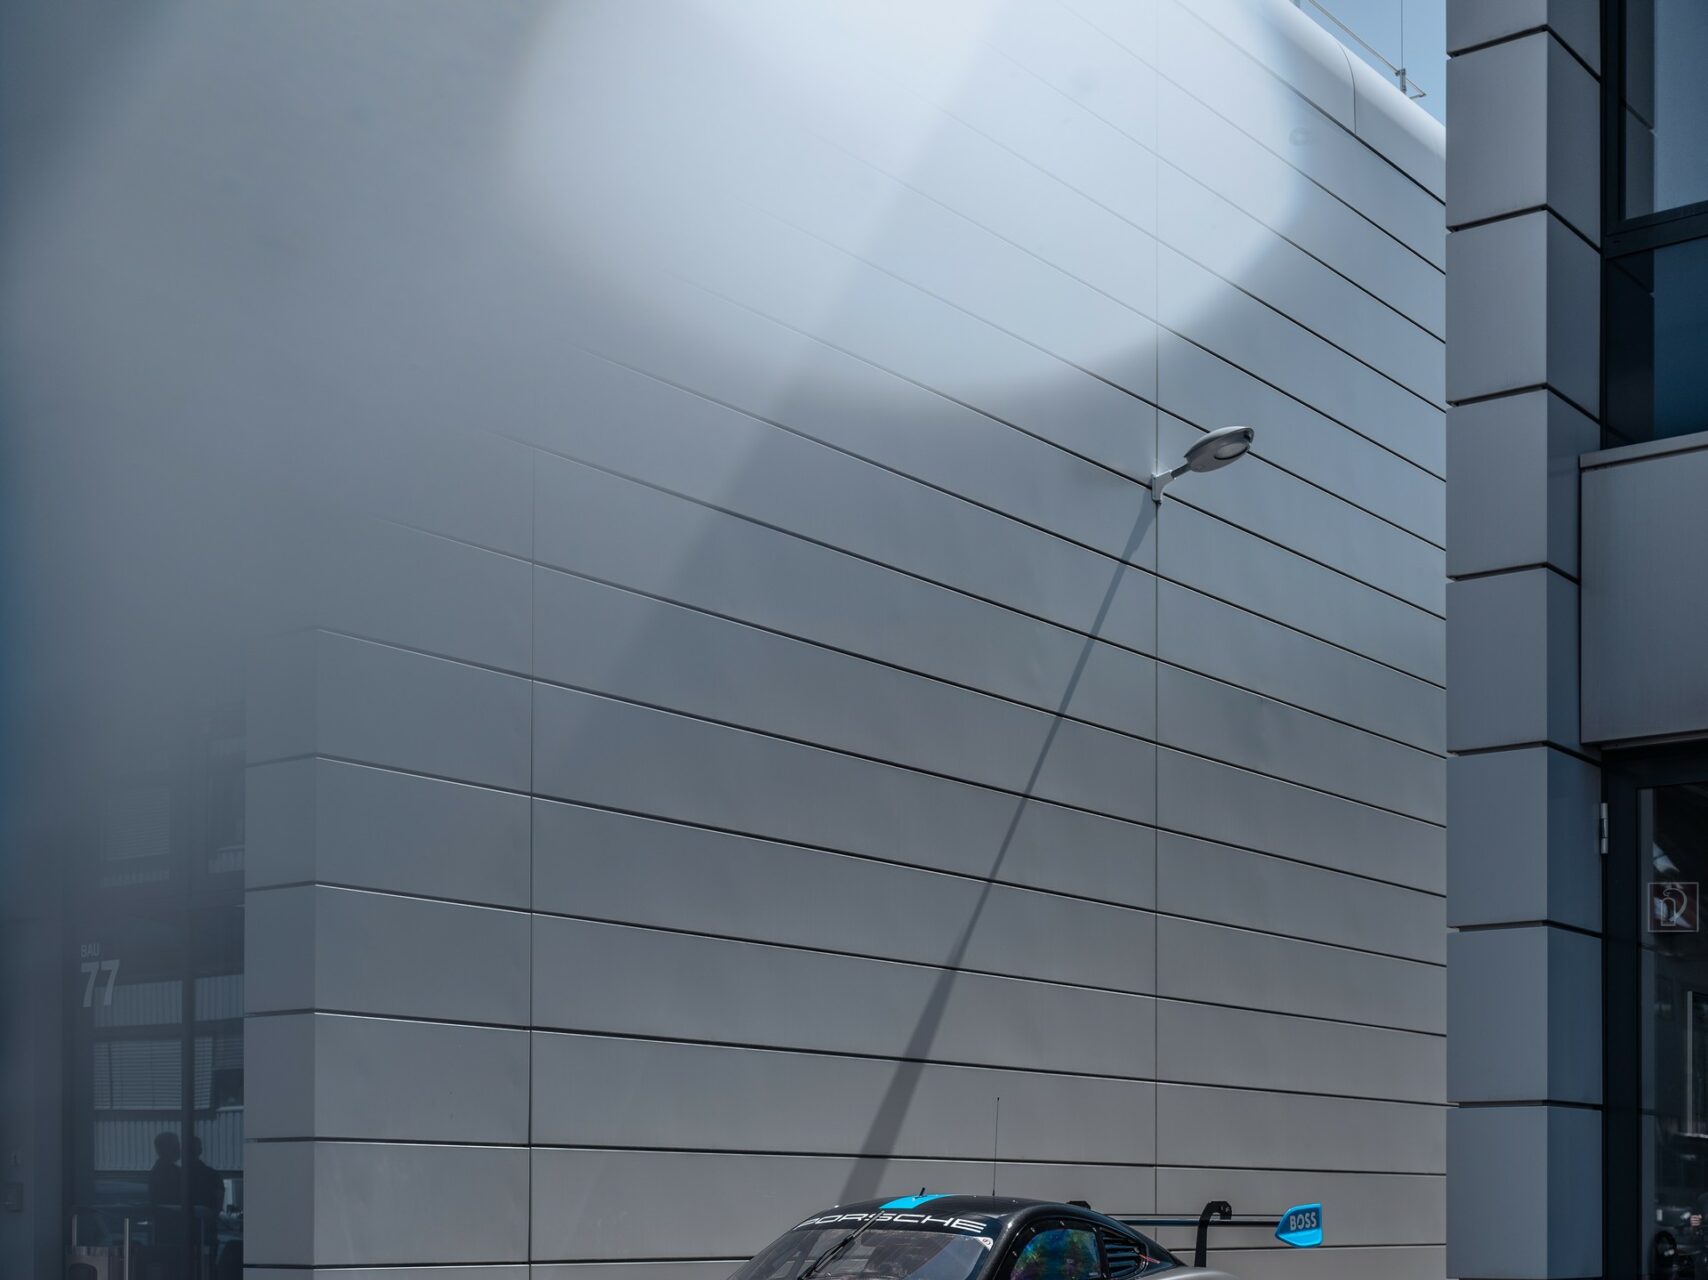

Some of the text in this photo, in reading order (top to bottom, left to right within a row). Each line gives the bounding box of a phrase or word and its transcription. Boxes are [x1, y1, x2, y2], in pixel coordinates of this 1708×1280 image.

[81, 944, 99, 957] BAU
[81, 959, 120, 1007] 77
[797, 1213, 987, 1233] PORSCHE
[1289, 1212, 1317, 1231] BOSS
